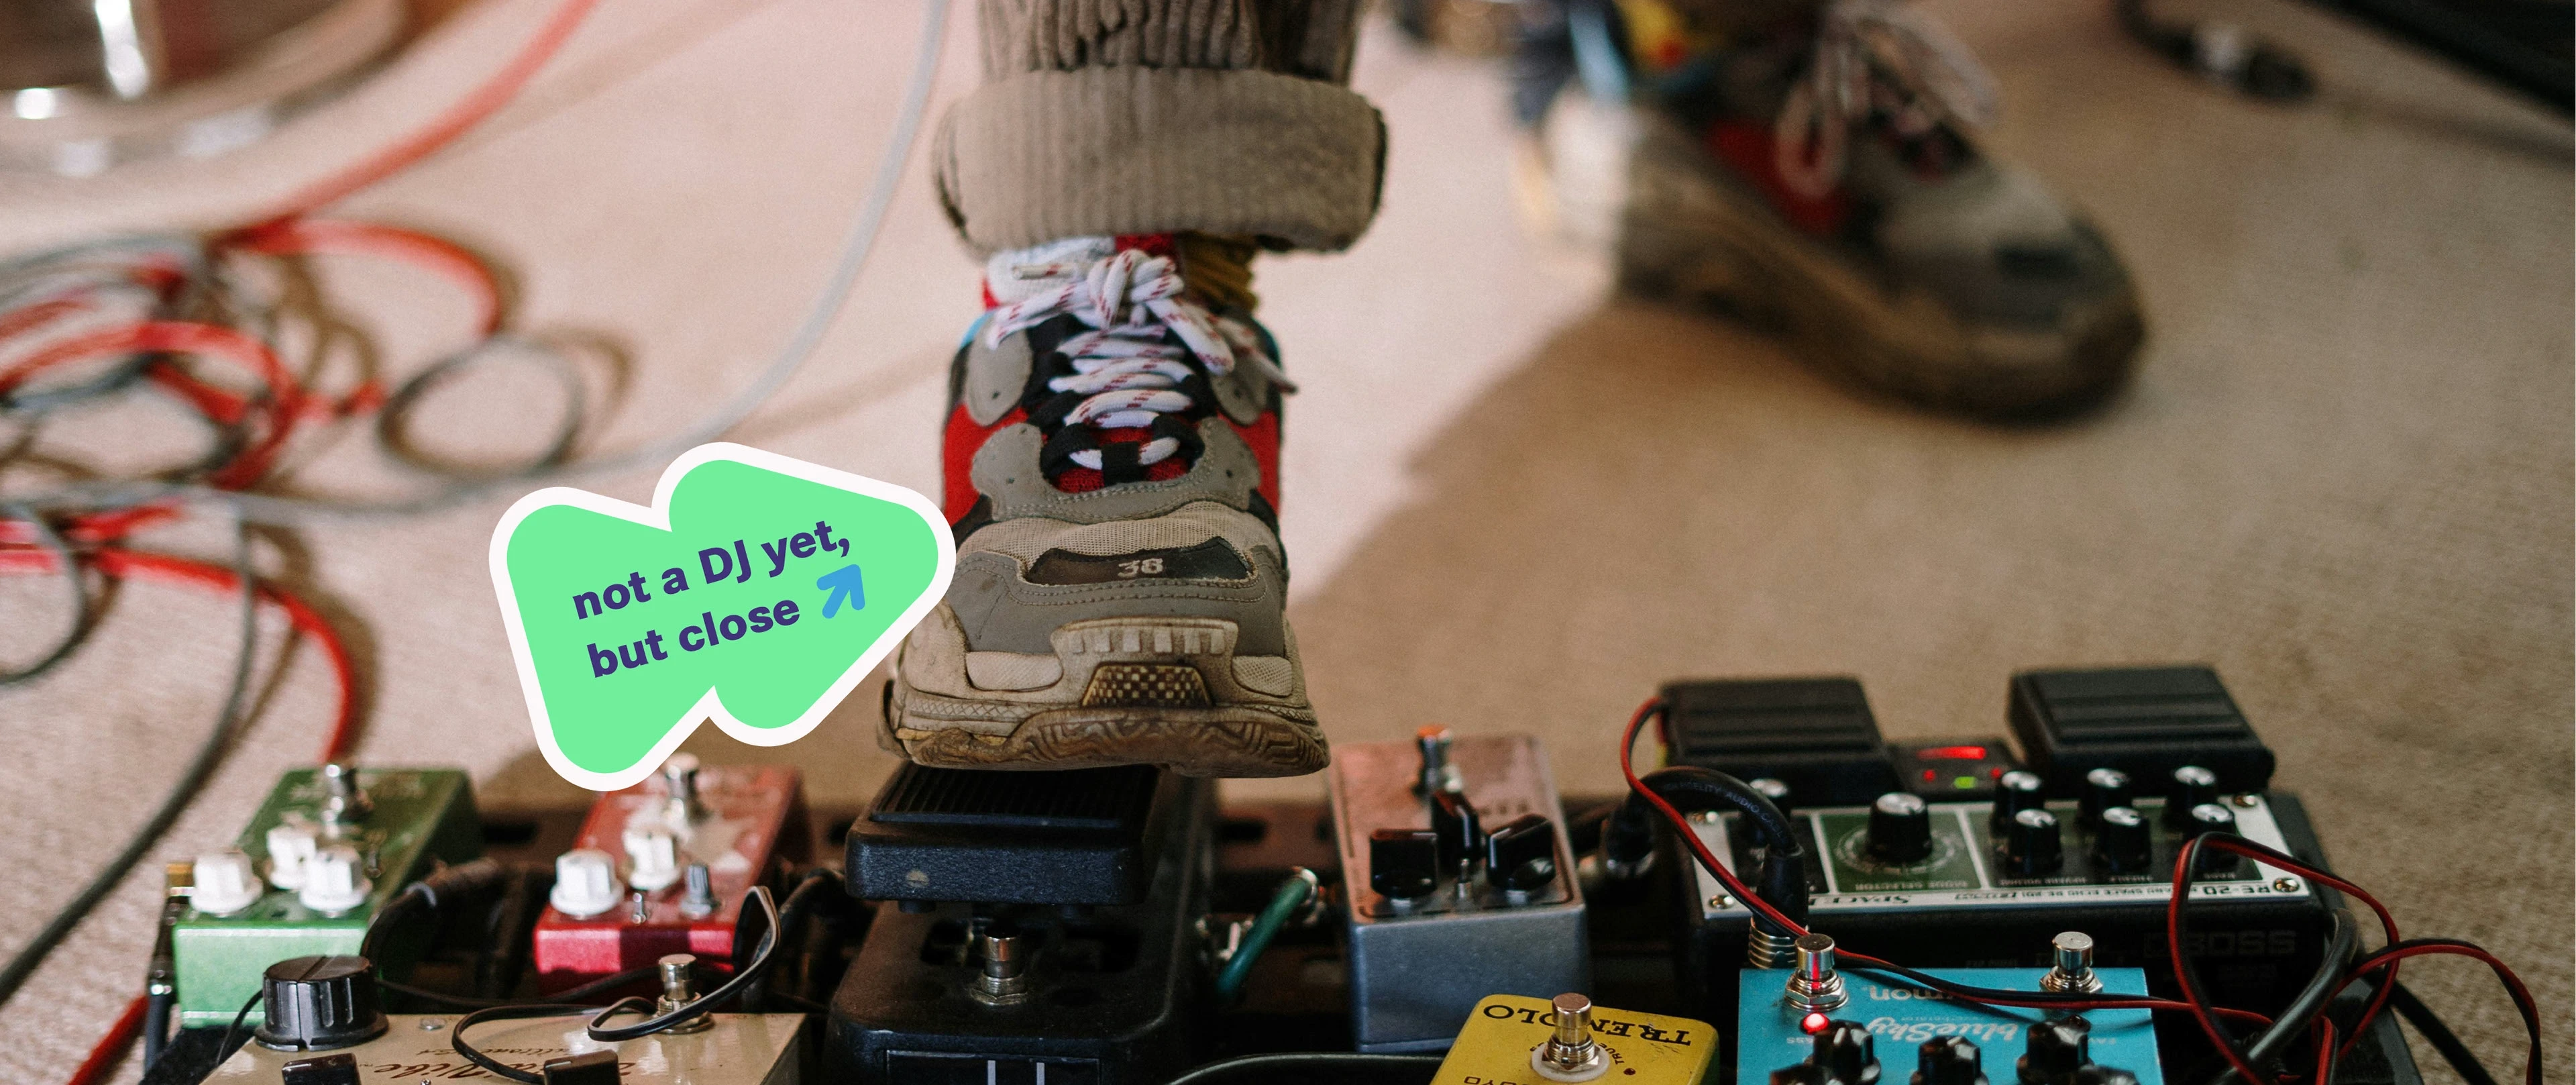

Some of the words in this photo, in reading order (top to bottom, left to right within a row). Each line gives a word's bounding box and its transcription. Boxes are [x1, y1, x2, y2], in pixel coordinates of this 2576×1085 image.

[1118, 558, 1163, 578] 38
[1725, 790, 1760, 813] AUDIO
[2202, 885, 2271, 896] RE-20
[1864, 1016, 2019, 1041] blueSky
[1599, 1041, 1625, 1065] TRUE
